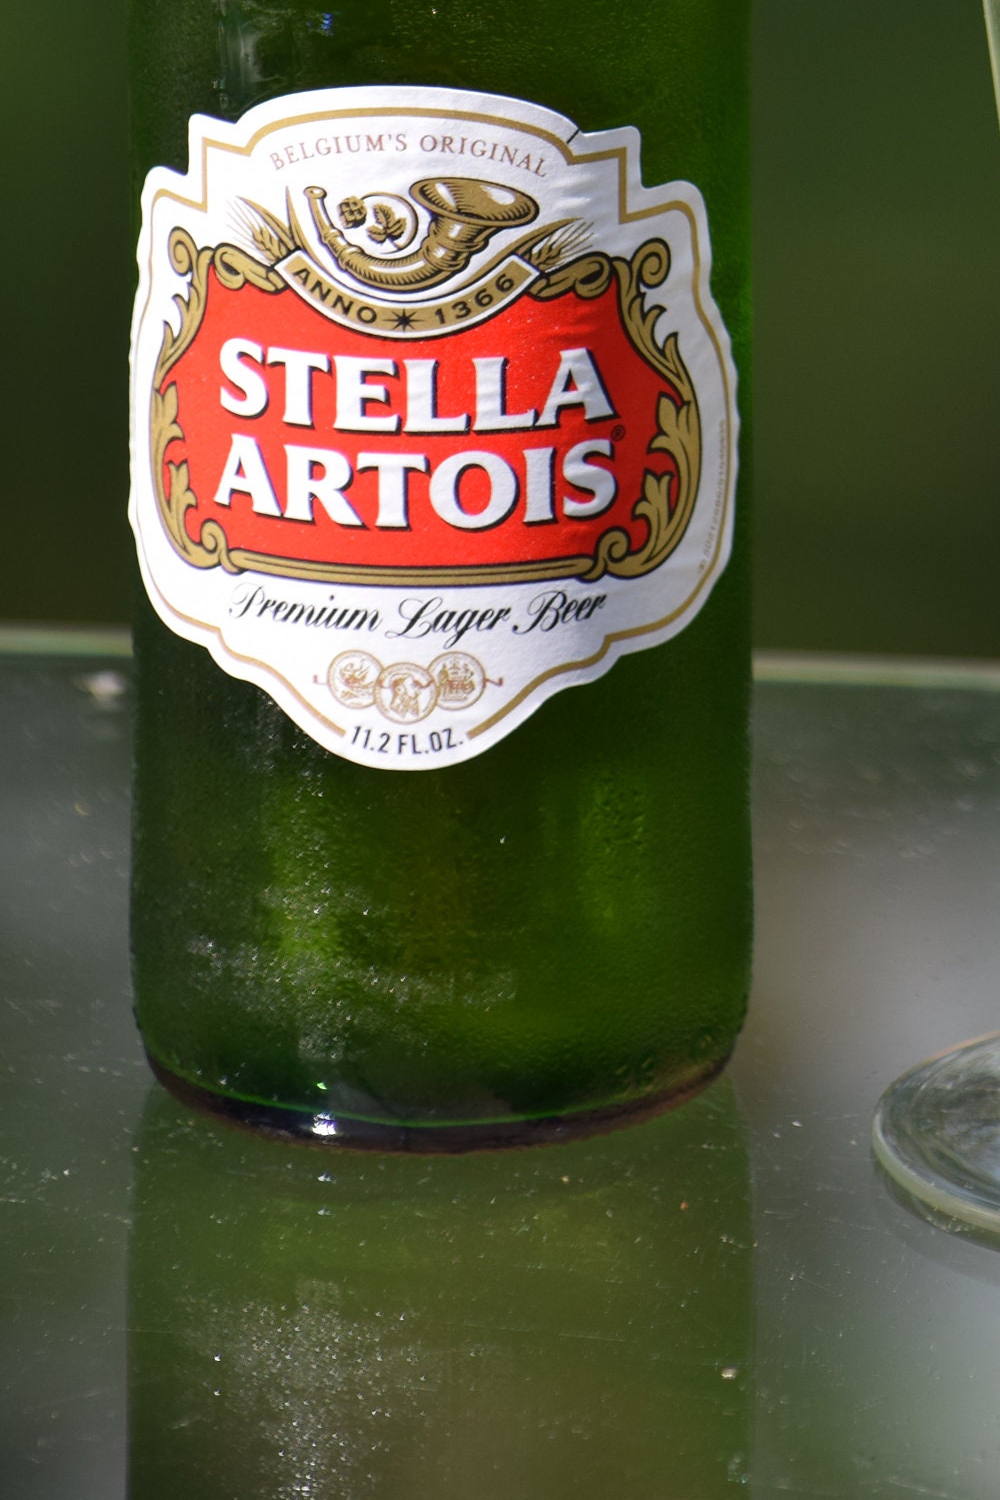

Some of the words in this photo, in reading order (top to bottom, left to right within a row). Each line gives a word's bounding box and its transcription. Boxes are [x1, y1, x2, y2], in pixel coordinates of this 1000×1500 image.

[268, 132, 408, 172] BELGIUM'S
[419, 134, 548, 178] ORIGINAL
[292, 267, 378, 324] ANNO
[434, 272, 515, 325] 1366
[218, 337, 617, 434] STELLA
[213, 432, 618, 530] ARTOIS
[228, 581, 383, 632] Premium
[384, 596, 512, 650] Lager
[511, 588, 609, 634] Beer
[350, 725, 392, 755] 11.2
